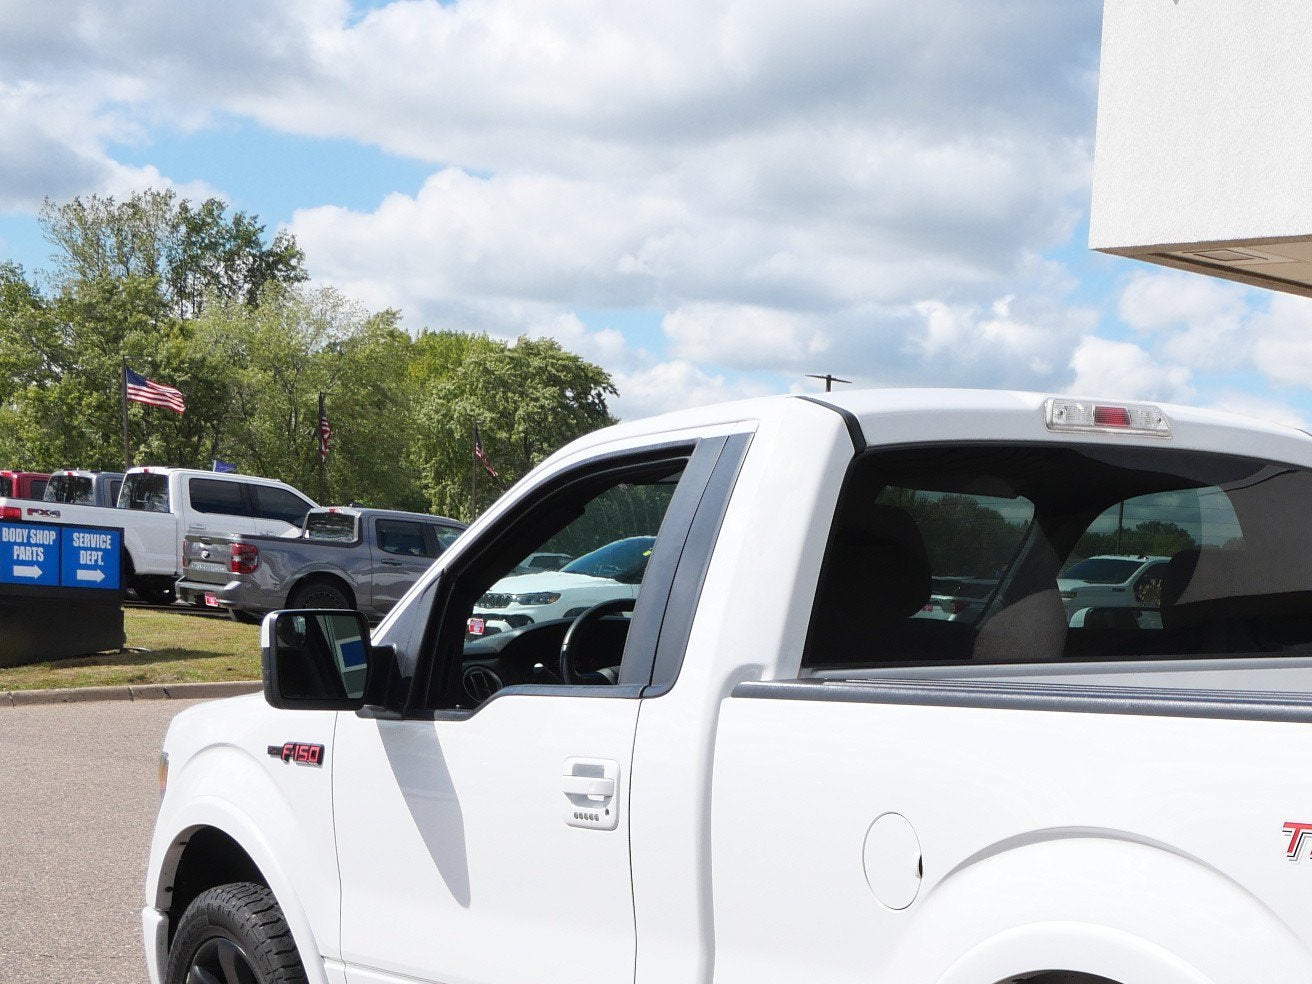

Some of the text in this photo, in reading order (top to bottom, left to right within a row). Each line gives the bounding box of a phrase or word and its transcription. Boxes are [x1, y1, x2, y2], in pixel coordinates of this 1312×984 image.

[1, 526, 56, 545] BODY SHOP
[73, 532, 111, 549] SERVICE
[13, 545, 44, 562] PARTS
[79, 550, 104, 566] DEPT.
